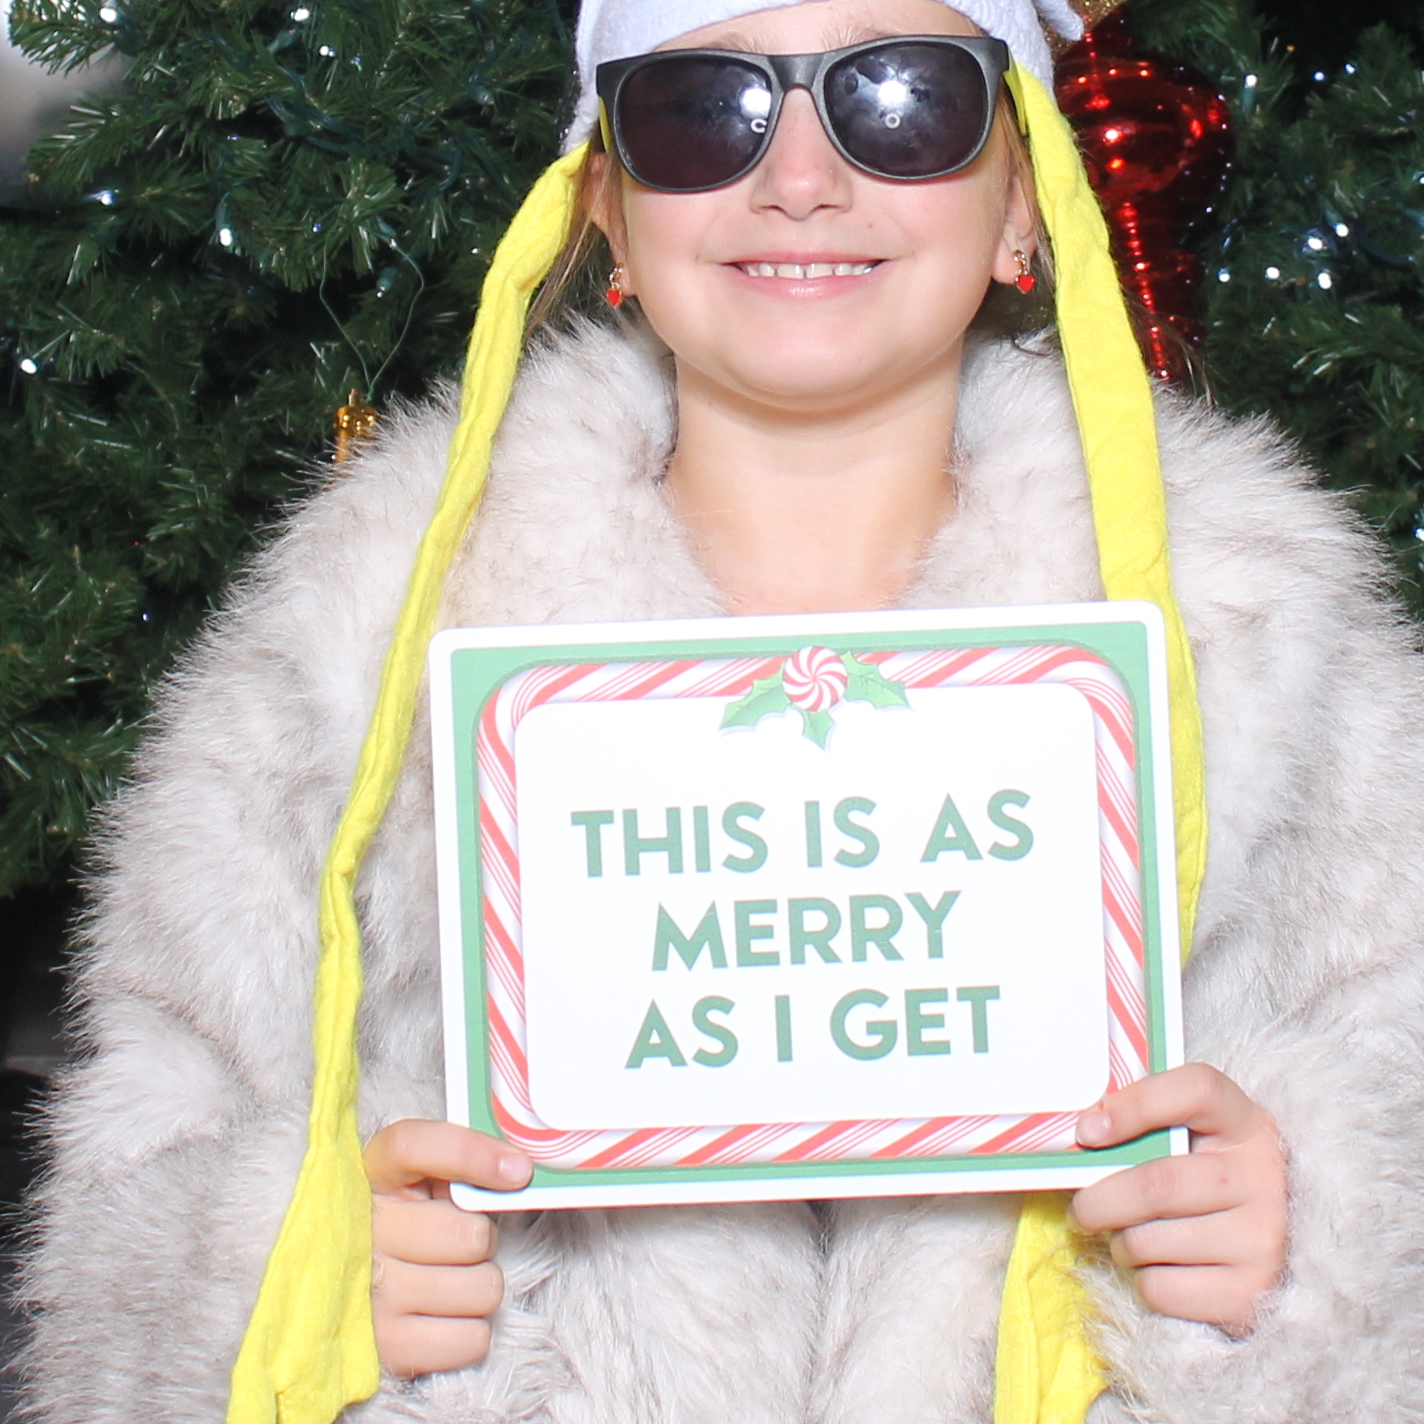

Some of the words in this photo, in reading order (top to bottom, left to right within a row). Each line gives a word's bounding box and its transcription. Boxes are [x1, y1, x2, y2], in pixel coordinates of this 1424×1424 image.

[571, 802, 768, 878] THIS
[805, 797, 880, 869] IS
[921, 789, 1034, 863] AS
[651, 891, 961, 972] MERRY
[624, 996, 739, 1070] AS
[775, 995, 793, 1063] I
[829, 986, 1001, 1062] GET
